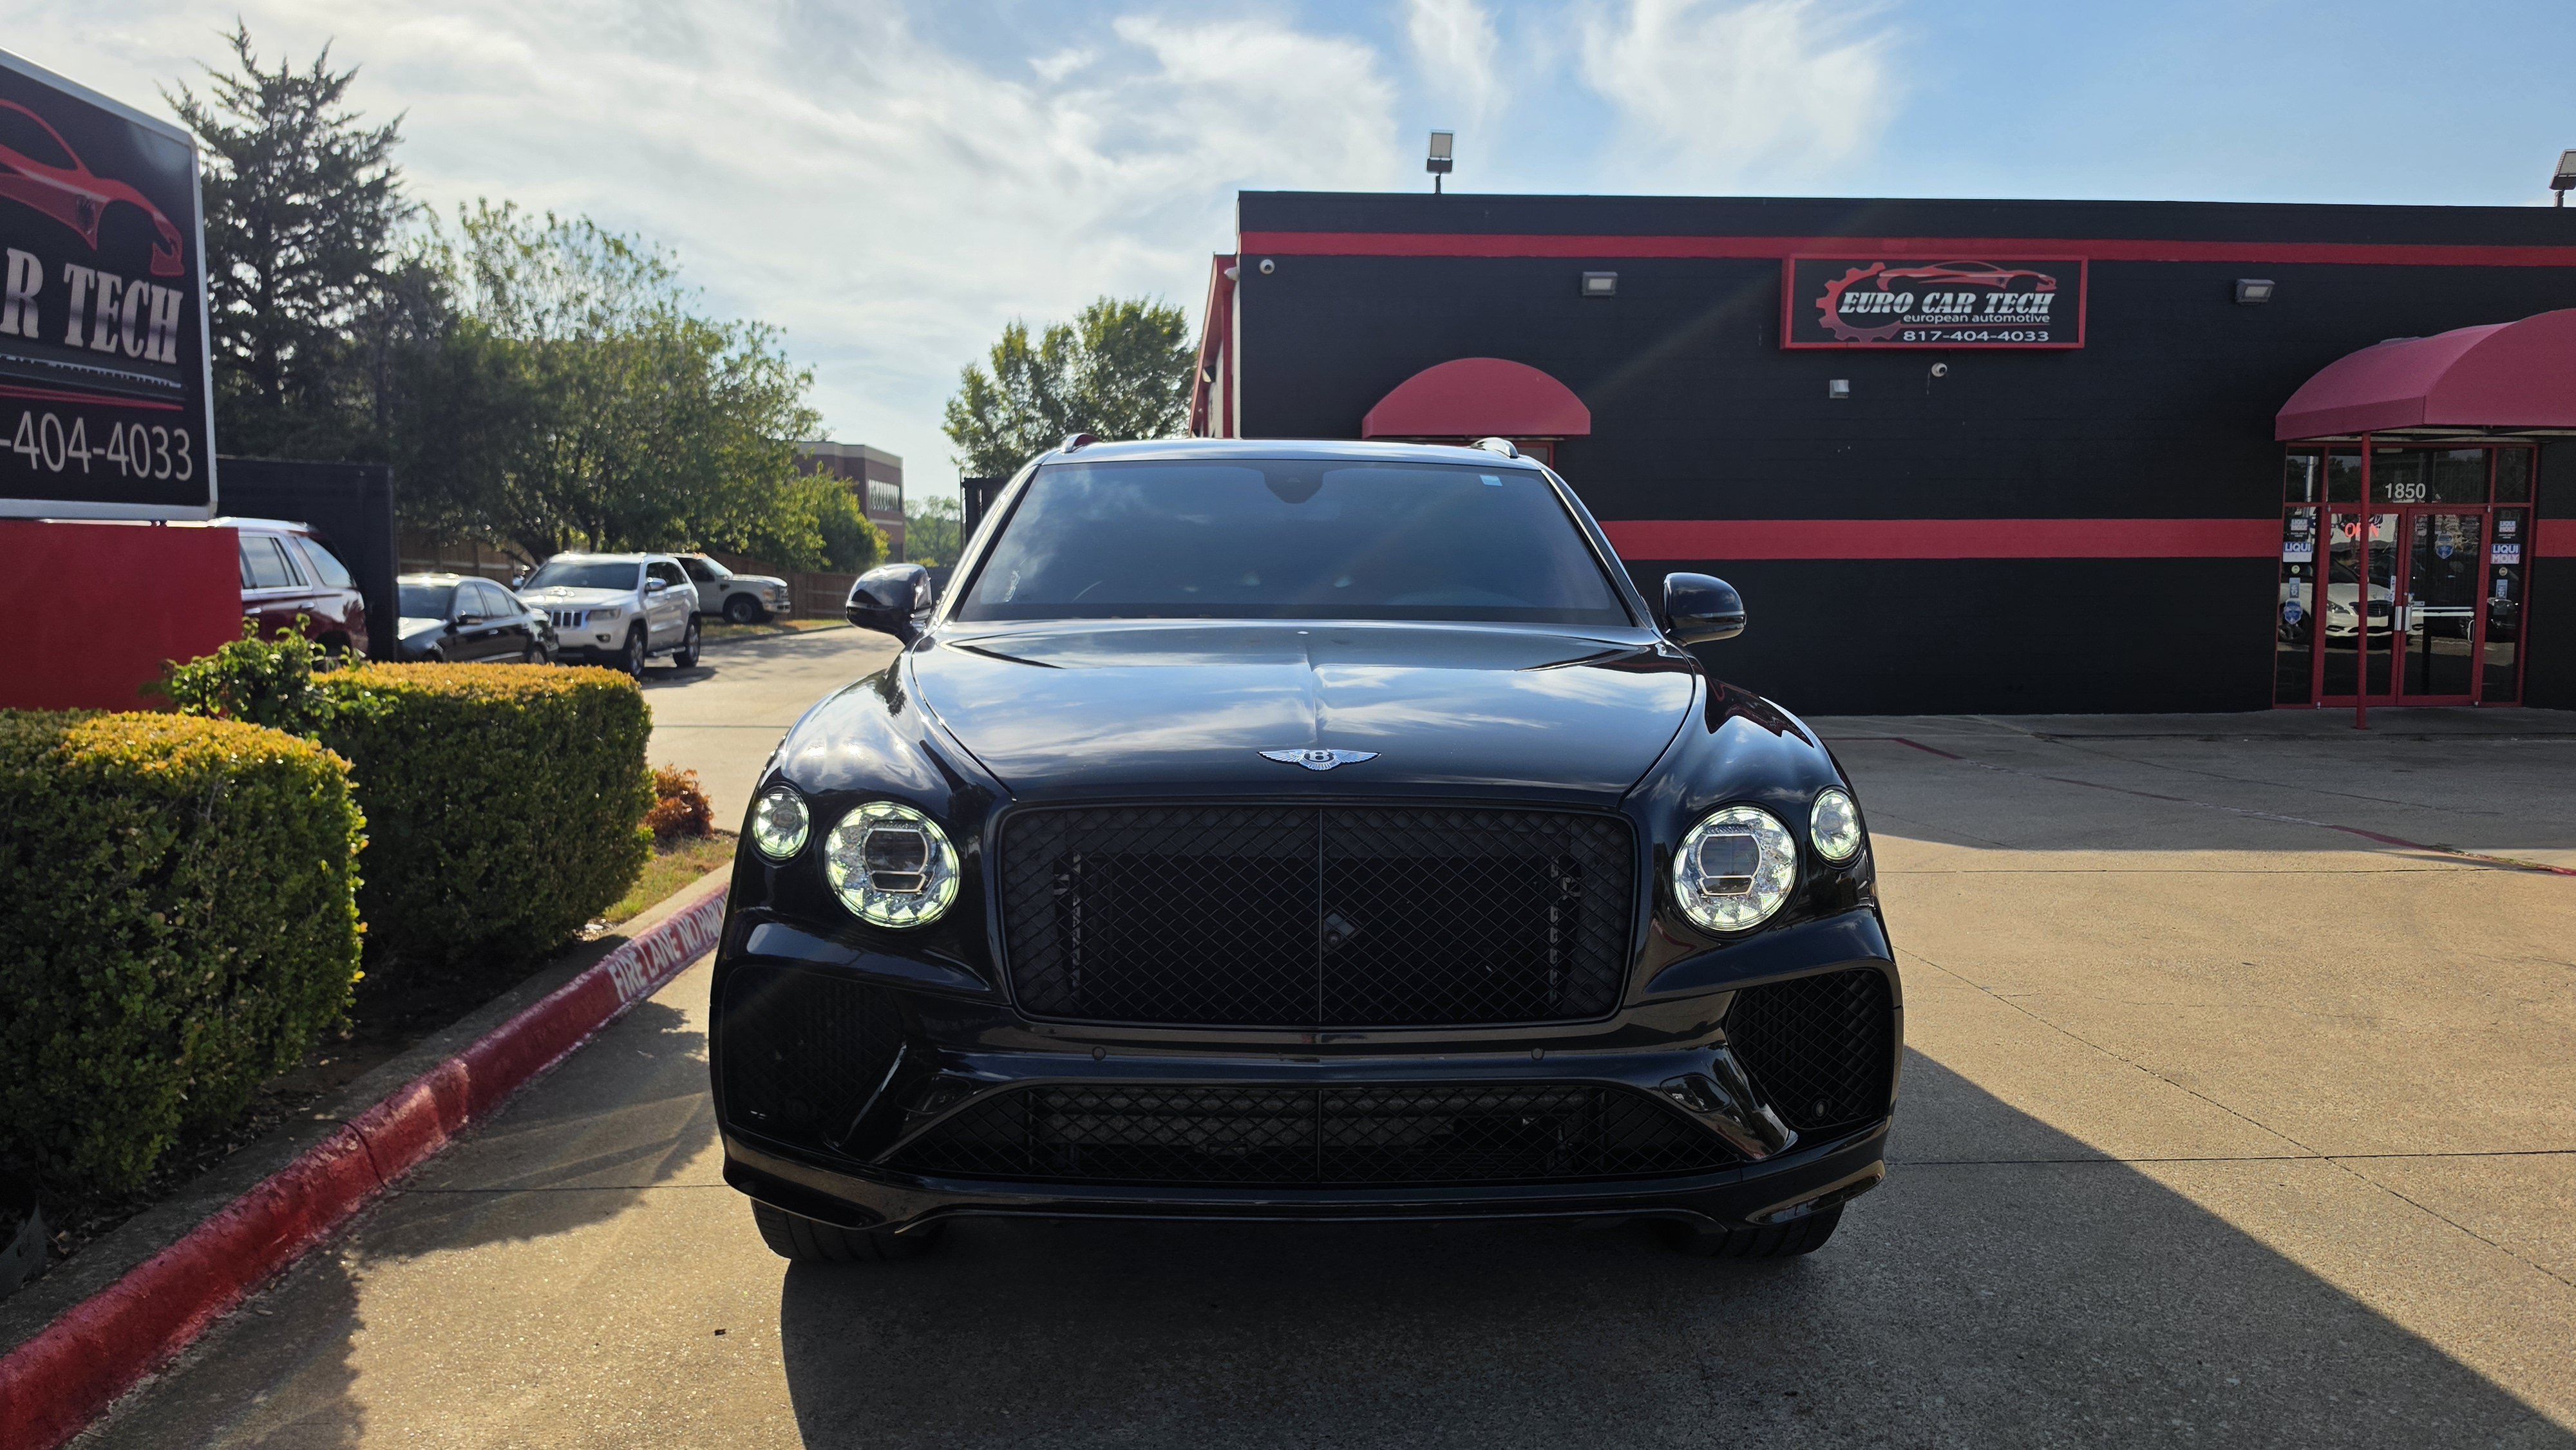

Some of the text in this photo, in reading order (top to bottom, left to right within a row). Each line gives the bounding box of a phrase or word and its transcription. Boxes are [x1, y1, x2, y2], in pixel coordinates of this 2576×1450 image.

[1839, 292, 2055, 314] EURO CAR TECH
[63, 263, 184, 364] TECH
[1903, 313, 2050, 324] european automotive
[1903, 330, 2049, 342] 817-404-4033
[2385, 483, 2426, 499] 1850
[2284, 542, 2311, 552] LIQUI
[2492, 545, 2519, 554] LIQUI
[2492, 554, 2519, 563] MOLY
[607, 952, 648, 1003] FIRE
[637, 927, 682, 978] LANE
[676, 916, 702, 956] NO
